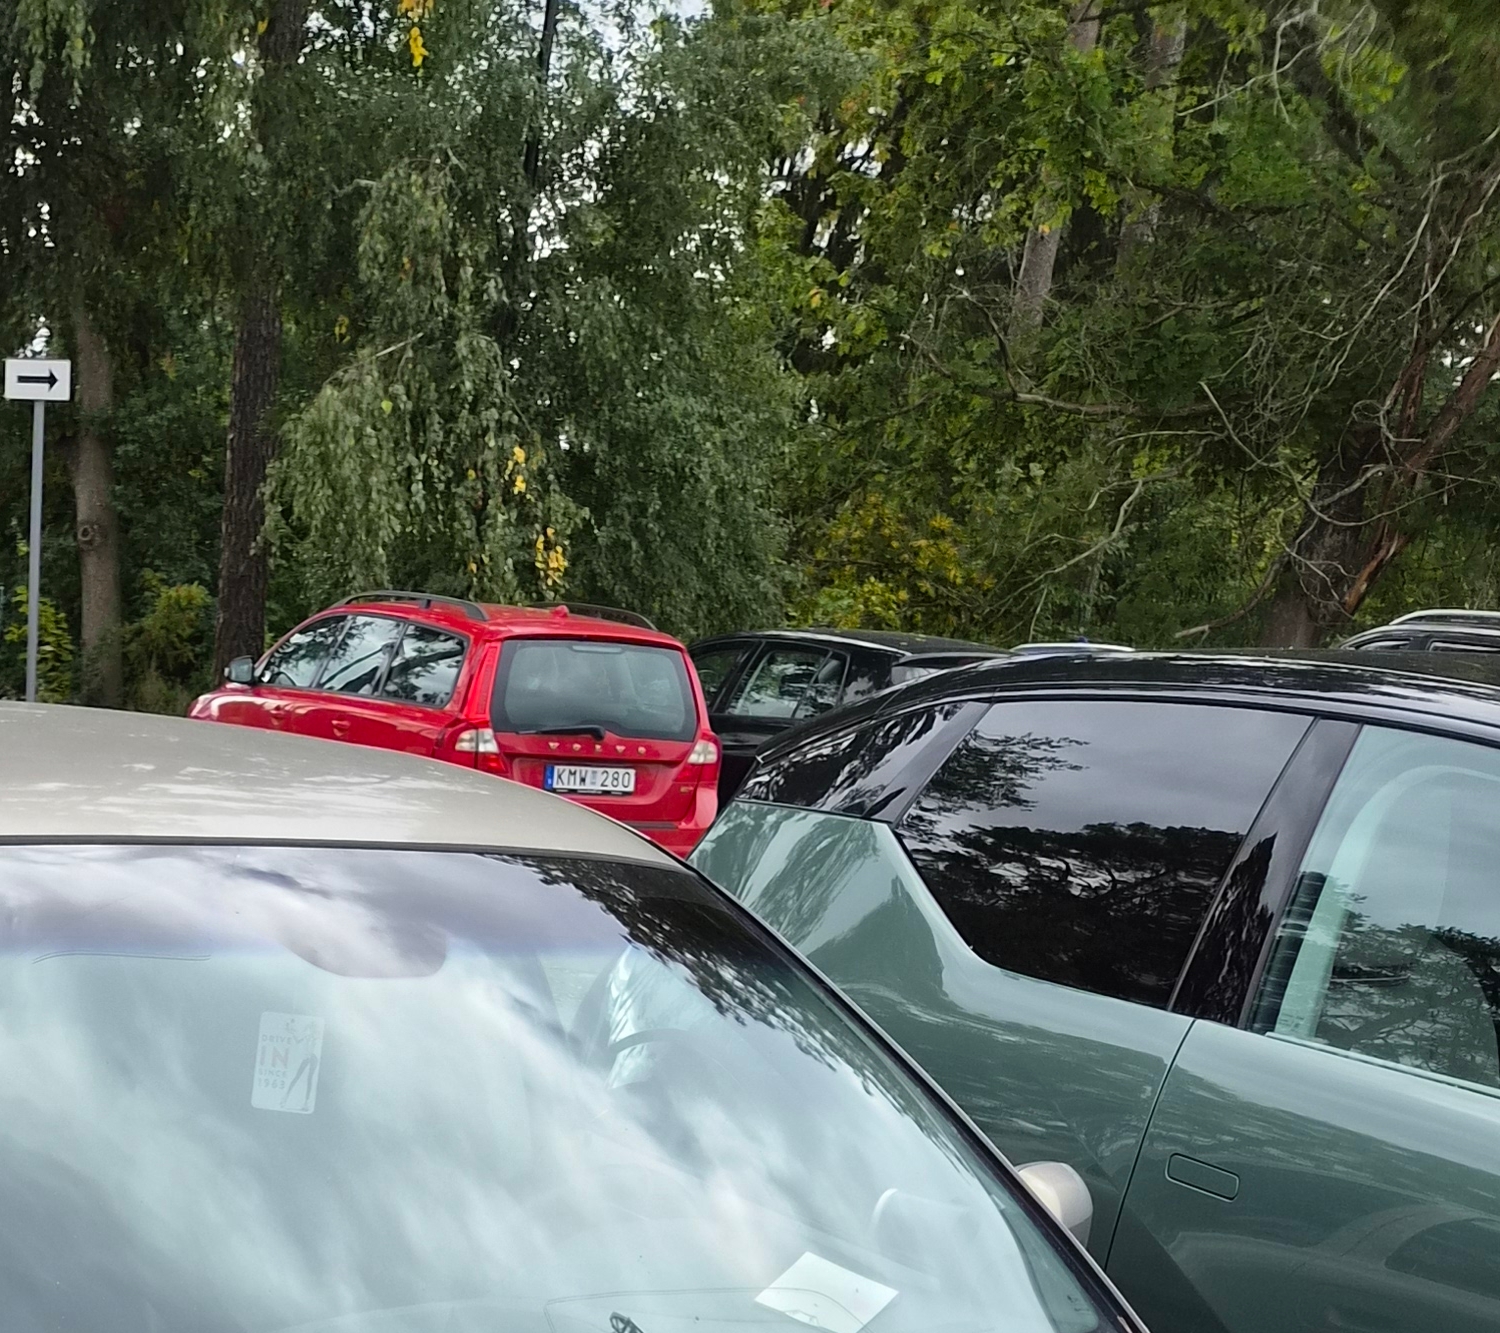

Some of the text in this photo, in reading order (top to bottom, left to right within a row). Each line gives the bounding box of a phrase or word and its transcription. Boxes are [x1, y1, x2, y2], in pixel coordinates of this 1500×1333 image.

[556, 768, 631, 788] KMW 280
[261, 1034, 292, 1045] DRIVE
[260, 1045, 289, 1069] IN
[258, 1068, 287, 1078] SINCE
[258, 1077, 286, 1090] 1963
